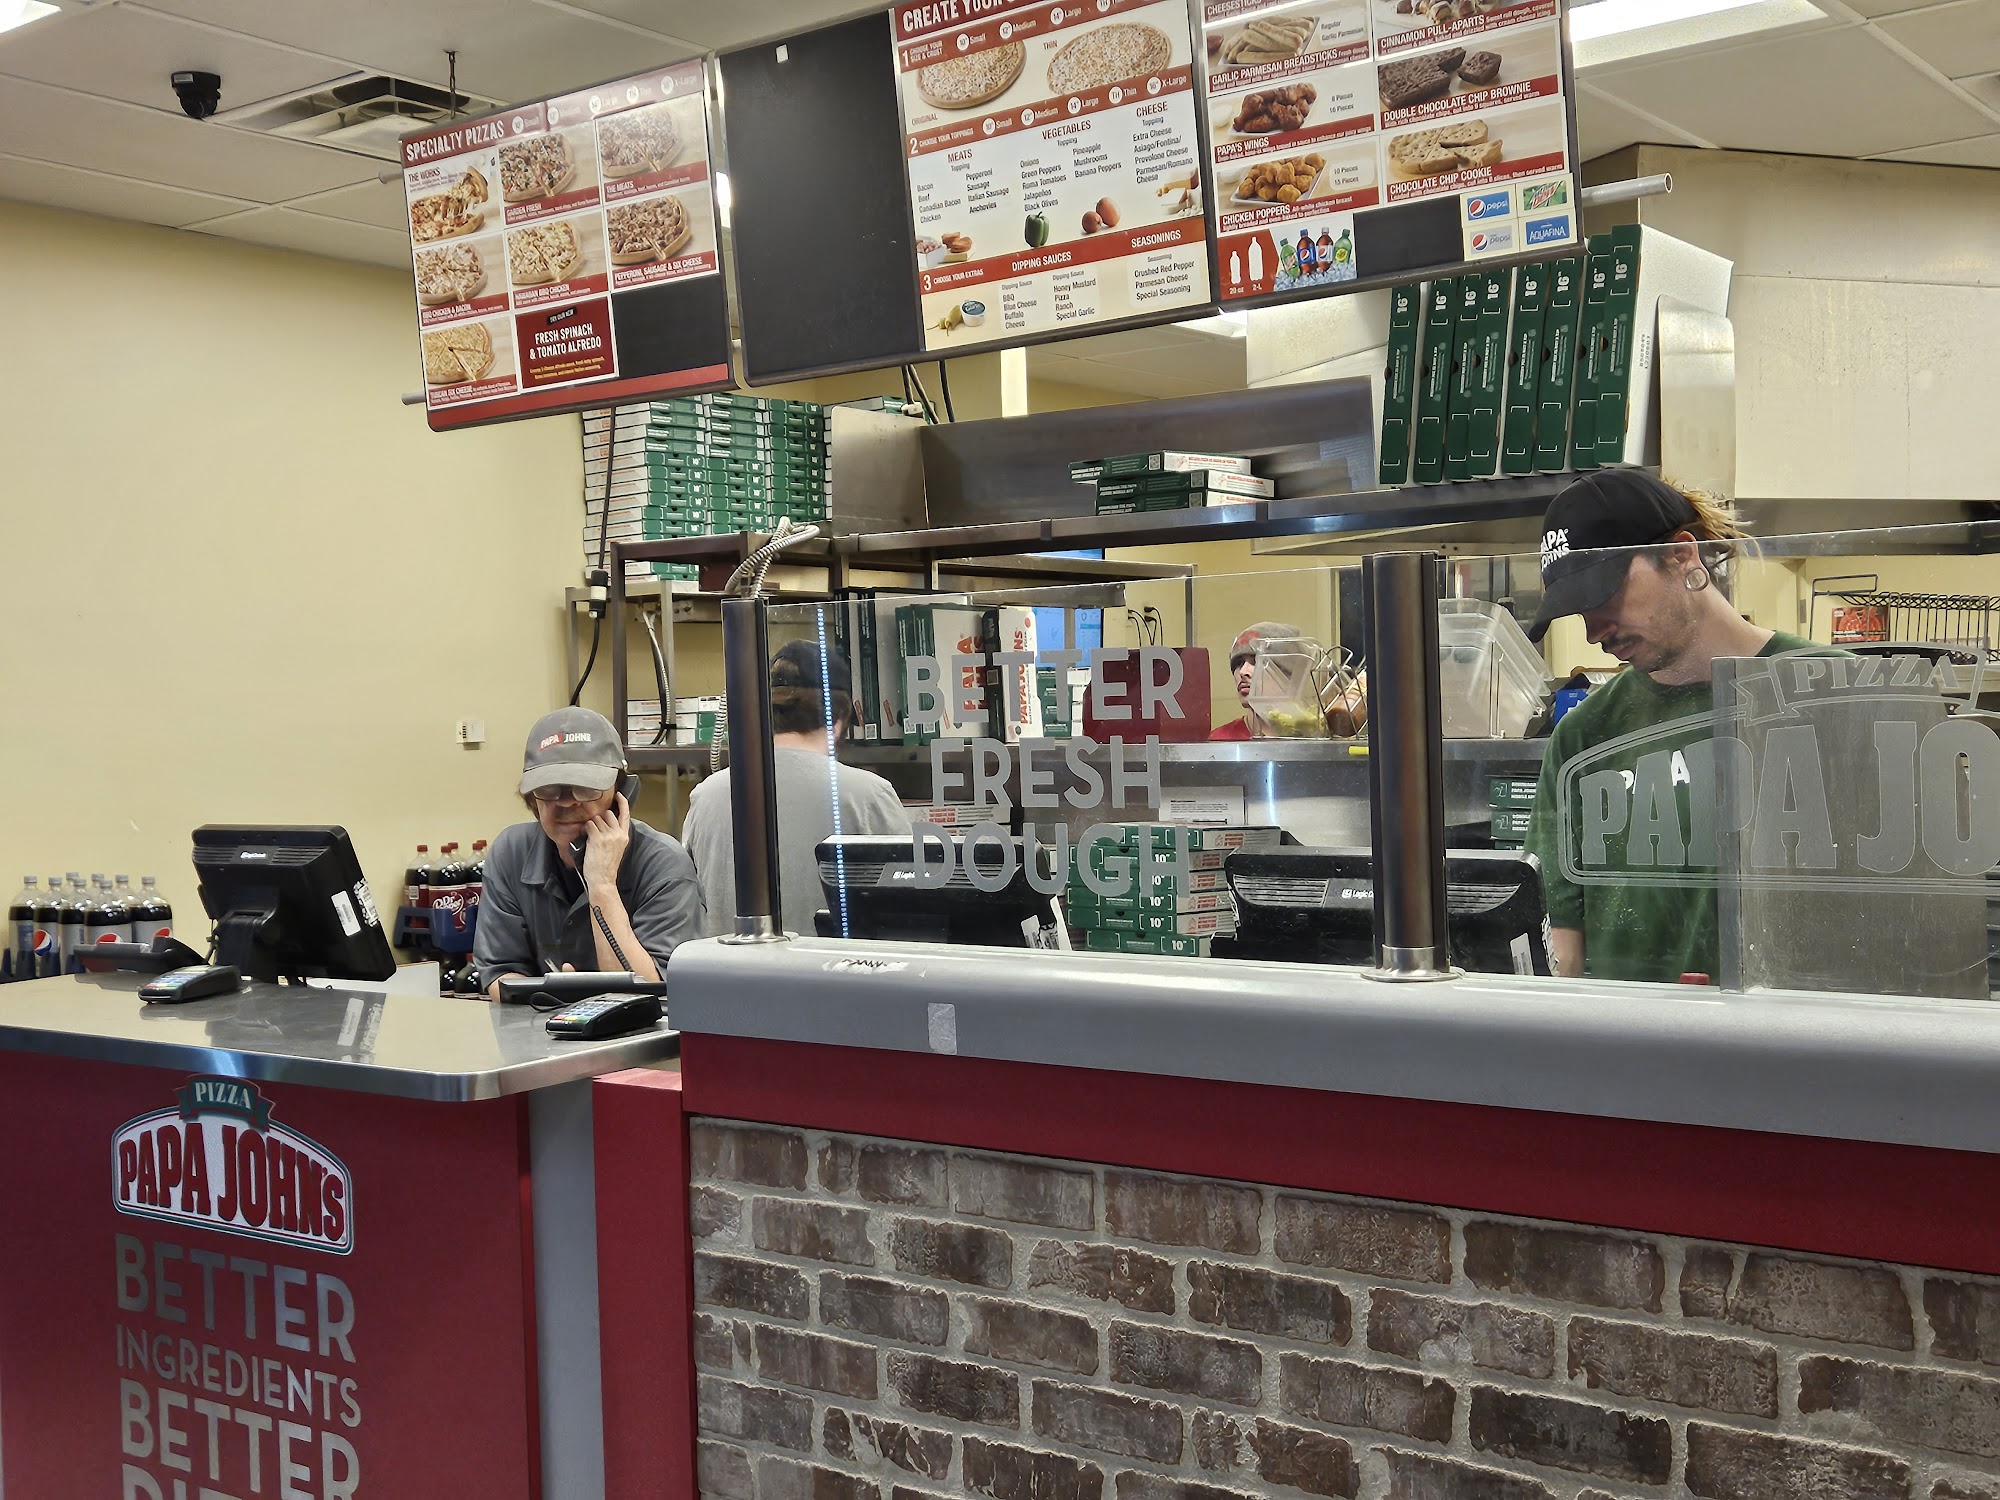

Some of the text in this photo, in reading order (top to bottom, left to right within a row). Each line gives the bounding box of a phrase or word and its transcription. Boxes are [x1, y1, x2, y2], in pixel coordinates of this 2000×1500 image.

[903, 0, 959, 32] CREATE
[1064, 7, 1082, 18] Large
[1013, 20, 1036, 32] Medium
[1321, 20, 1342, 30] Regular
[1380, 15, 1484, 49] CINNAMON PULL-APARTS
[970, 33, 986, 44] Small
[1322, 27, 1364, 41] Garlic Parmesan
[1043, 40, 1058, 50] THIN
[1212, 49, 1338, 85] GARLIC PARMESAN BREADSTICKS
[1162, 75, 1187, 88] X-Large
[1123, 87, 1137, 96] Thin
[1081, 97, 1099, 108] Large
[1136, 101, 1168, 118] CHEESE
[1384, 82, 1532, 122] DOUBLE CHOCOLATE CHIP BROWNIE
[912, 113, 938, 126] ORIGINAL
[1035, 106, 1058, 118] Medium
[995, 118, 1013, 128] Small
[1142, 116, 1164, 127] Topping
[1042, 119, 1092, 140] VEGETABLES
[1132, 127, 1172, 142] Extra Cheese
[406, 120, 505, 162] SPECIALTY PIZZAS
[910, 137, 919, 154] 2
[1057, 136, 1078, 147] Topping
[1133, 135, 1182, 153] Asiago/Fontina/
[1217, 137, 1269, 156] PAPA'S WINGS
[947, 149, 973, 163] MEATS
[1072, 143, 1101, 156] Pineapple
[1135, 147, 1189, 165] Provolone Cheese
[951, 162, 970, 172] Topping
[1019, 158, 1040, 168] Onions
[1073, 153, 1108, 167] Mushrooms
[1136, 157, 1193, 176] Parmesan/Romano
[409, 167, 441, 183] THE WORKS
[965, 168, 993, 180] Pepperoni
[1021, 164, 1062, 179] Green Peppers
[1074, 162, 1122, 178] Banana Peppers
[1342, 165, 1359, 173] Pieces
[967, 181, 990, 191] Sausage
[1022, 174, 1067, 190] Roma Tomatoes
[1136, 173, 1159, 184] Cheese
[1390, 166, 1492, 195] CHOCOLATE CHIP COOKIE
[606, 184, 616, 194] THE
[616, 181, 634, 192] MEATS
[917, 183, 934, 192] Bacon
[968, 187, 1009, 202] Italian Sausage
[918, 194, 930, 202] Beef
[1024, 198, 1058, 212] Black Olives
[1486, 198, 1508, 212] pepsi
[918, 198, 961, 214] Canadian Bacon
[969, 201, 997, 214] Anchovies
[920, 212, 942, 224] Chicken
[1222, 204, 1290, 225] CHICKEN POPPERS
[1131, 229, 1182, 248] SEASONINGS
[1490, 234, 1510, 245] pepsi
[1530, 226, 1566, 241] AQUAFINA
[643, 264, 667, 275] SAUSAGE
[668, 262, 673, 270] &
[673, 261, 682, 269] SIX
[682, 256, 702, 267] CHEESE
[1011, 251, 1072, 272] DIPPING SAUCES
[1134, 260, 1195, 278] Crushed Red Pepper
[923, 274, 932, 290] 3
[934, 269, 984, 284] CHOOSE YOUR EXTRAS
[1135, 275, 1188, 289] Parmesan Cheese
[1053, 278, 1097, 292] Honey Mustard
[1136, 284, 1191, 300] Special Seasoning
[1003, 293, 1015, 302] BBQ
[1003, 299, 1037, 311] Blue Cheese
[1055, 302, 1074, 311] Ranch
[1004, 311, 1025, 321] Buffalo
[1056, 308, 1095, 321] Special Garlic
[1005, 320, 1025, 329] Cheese
[534, 323, 593, 345] FRESH SPINACH
[529, 336, 601, 360] & TOMATO ALFREDO
[1540, 529, 1568, 553] APA
[1791, 654, 1960, 693] PIZZA
[905, 645, 1186, 725] BETTER
[541, 735, 560, 749] PAPA
[930, 735, 1161, 810] FRESH
[1579, 723, 1838, 870] PAPA
[911, 821, 1189, 897] DOUGH
[193, 1080, 252, 1111] PIZZA
[118, 1121, 347, 1243] PAPA JOHN'S
[113, 1231, 357, 1364] BETTER
[115, 1323, 363, 1429] INGREDIENTS
[119, 1378, 361, 1500] BETTER
